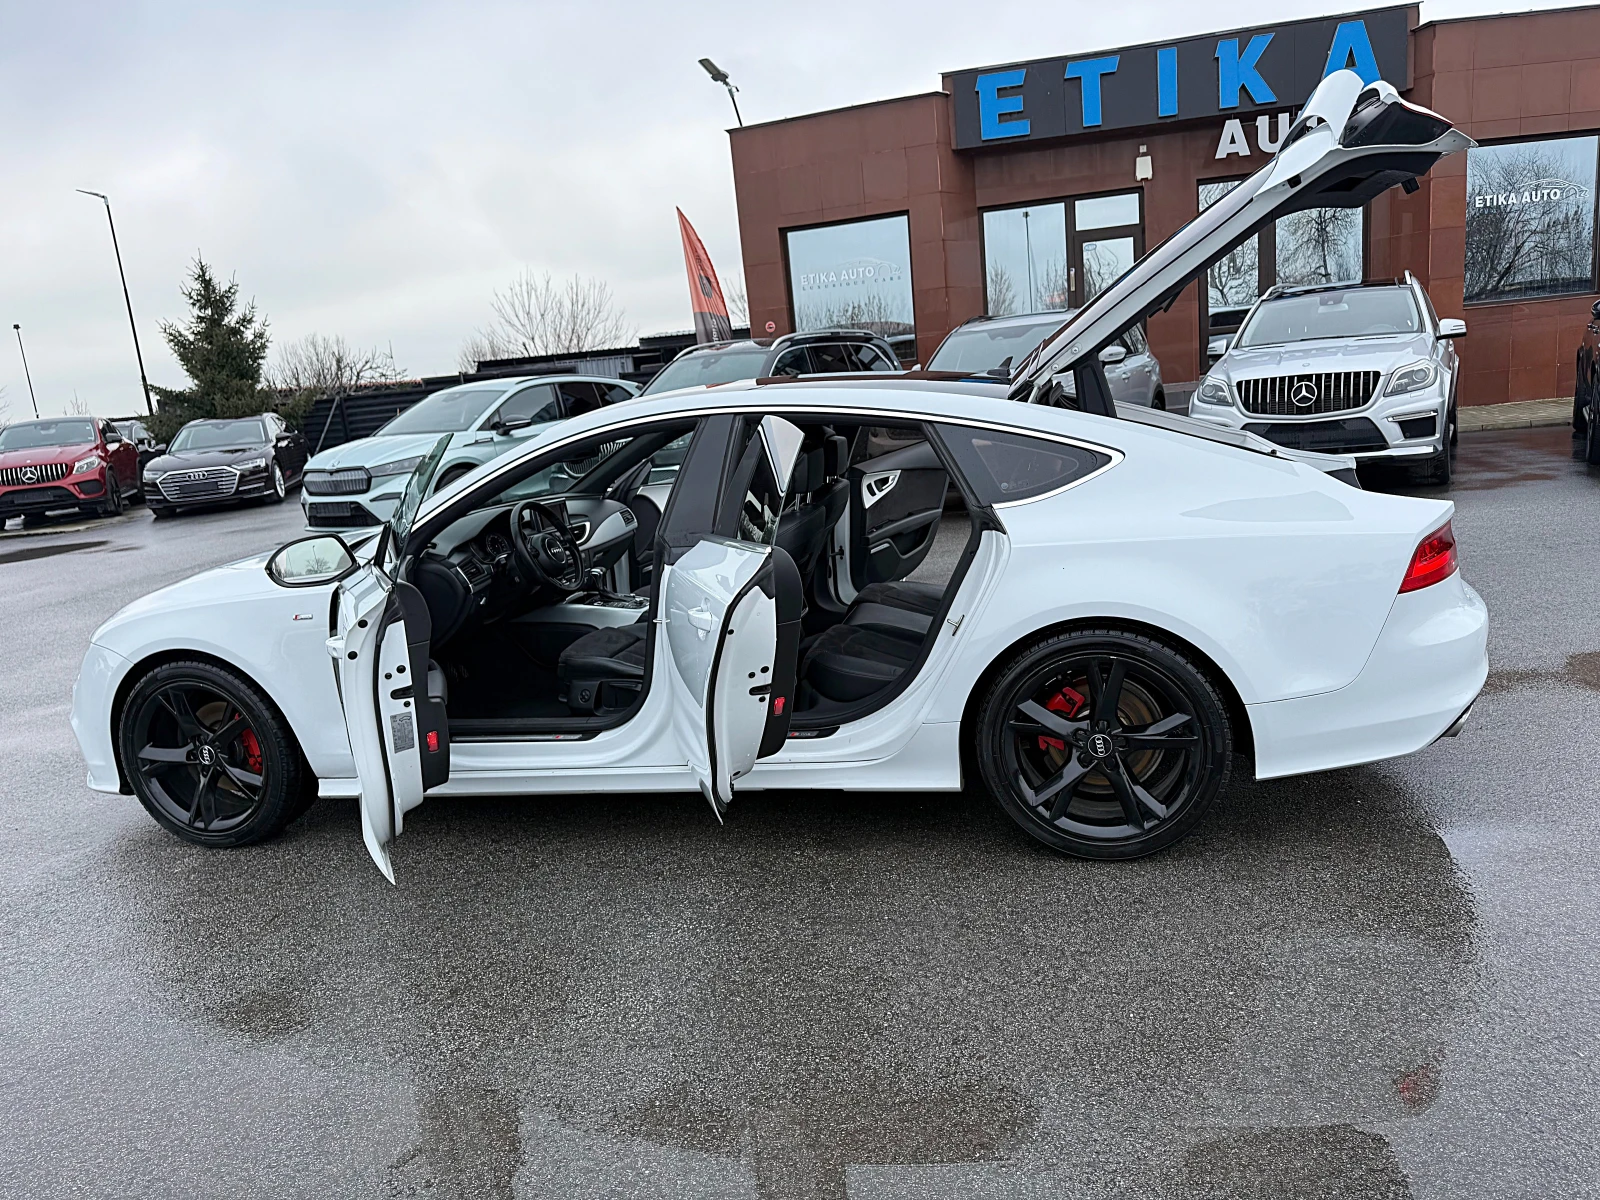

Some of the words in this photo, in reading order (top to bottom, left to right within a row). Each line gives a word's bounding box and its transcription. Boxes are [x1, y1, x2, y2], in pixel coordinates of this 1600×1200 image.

[975, 19, 1381, 141] ETIKA
[1215, 111, 1318, 159] AU
[1475, 193, 1517, 208] ETIKA
[1521, 188, 1560, 203] AUTO
[800, 271, 837, 286] ETIKA
[840, 266, 875, 281] AUTO
